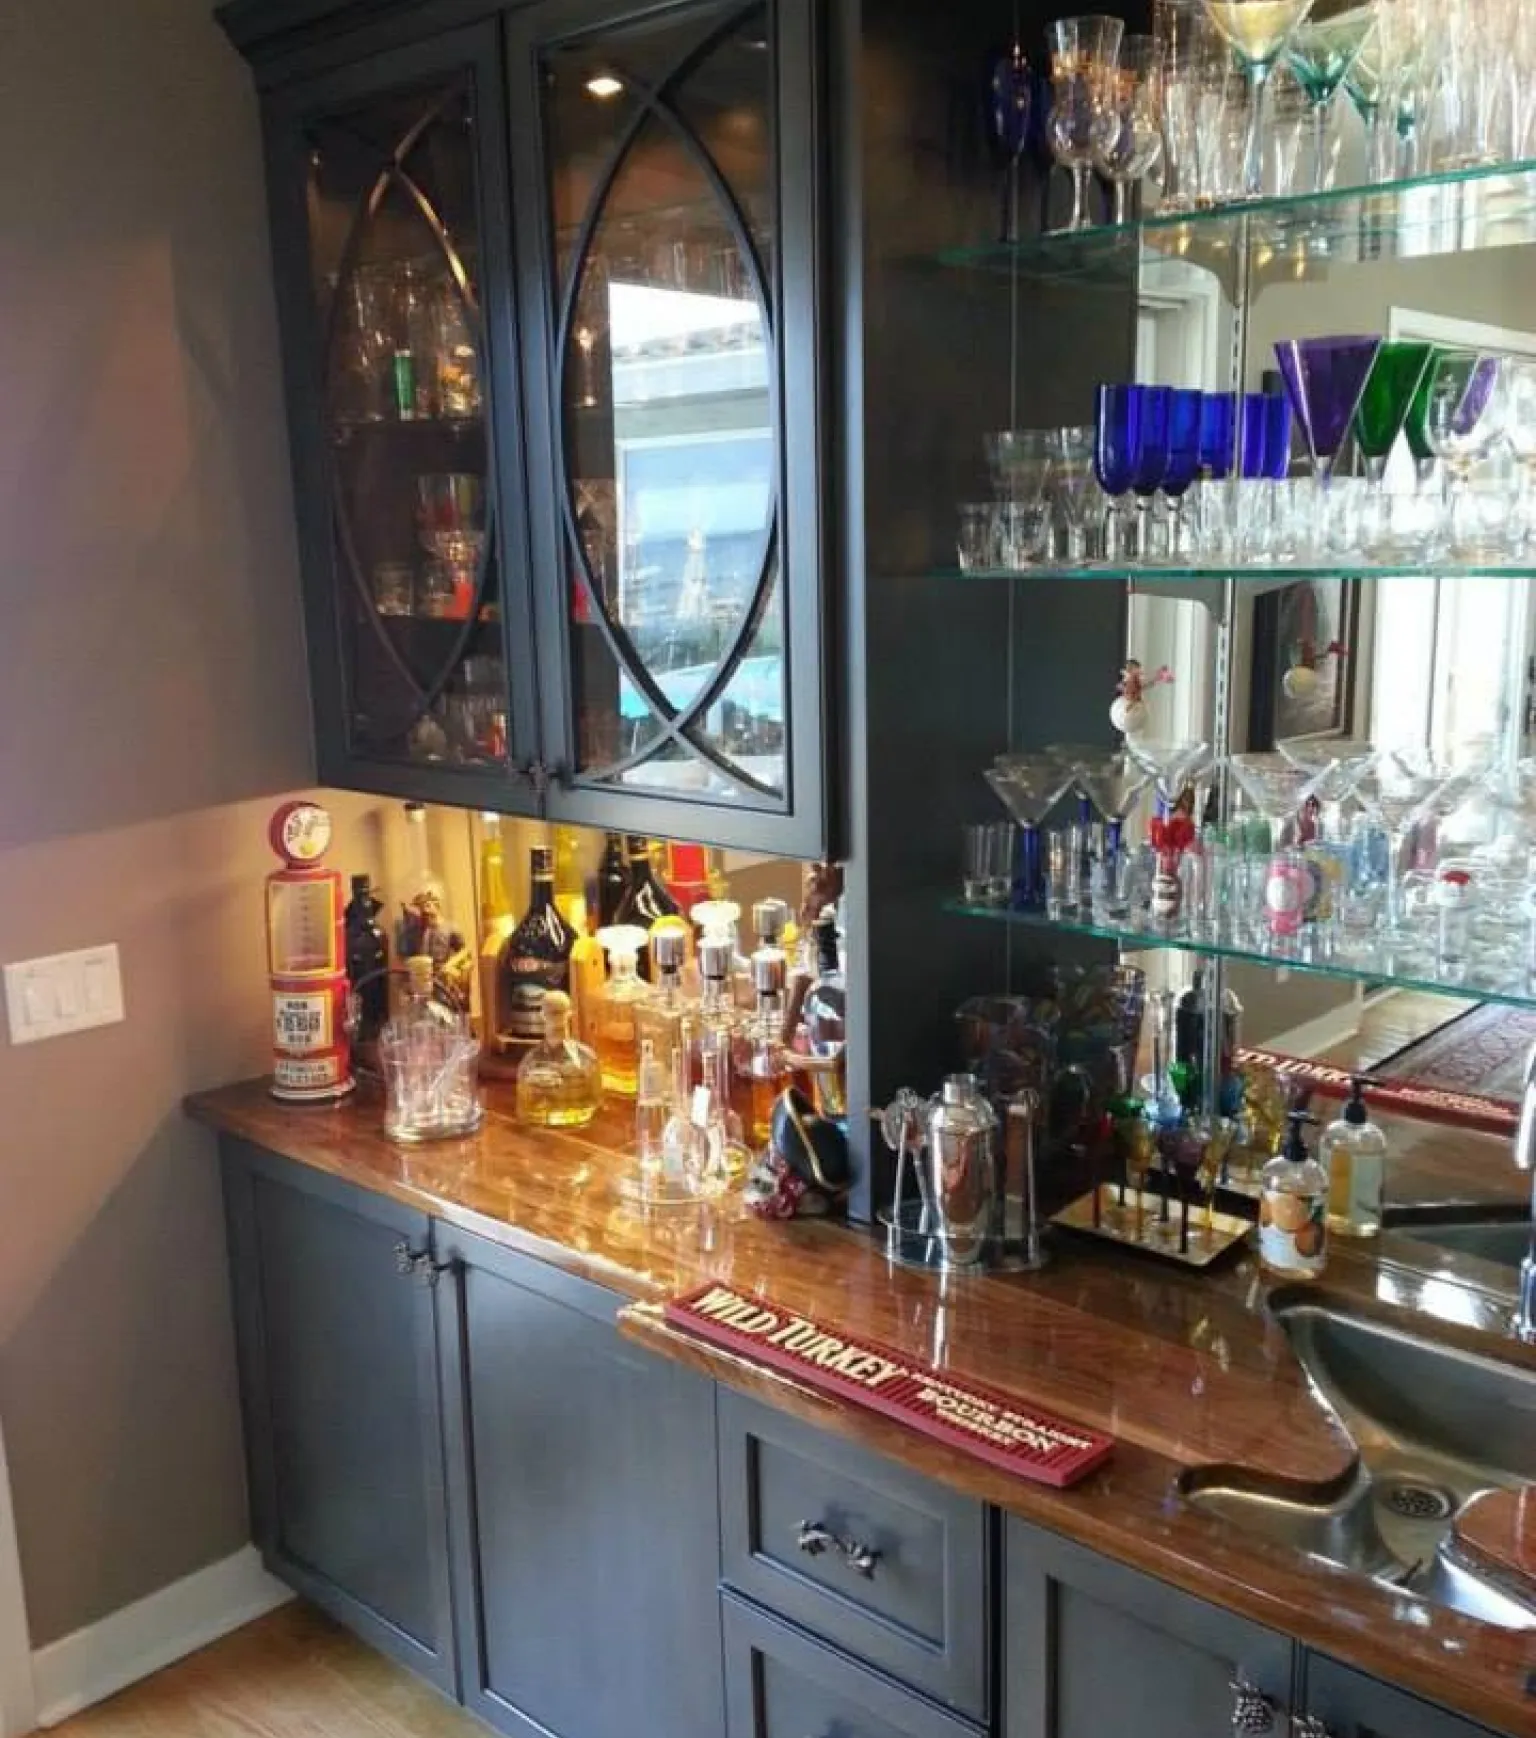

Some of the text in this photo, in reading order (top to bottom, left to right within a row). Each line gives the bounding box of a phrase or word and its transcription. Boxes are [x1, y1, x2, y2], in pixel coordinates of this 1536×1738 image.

[691, 1287, 909, 1386] WILD TURKEY
[917, 1387, 1059, 1451] BOURBON
